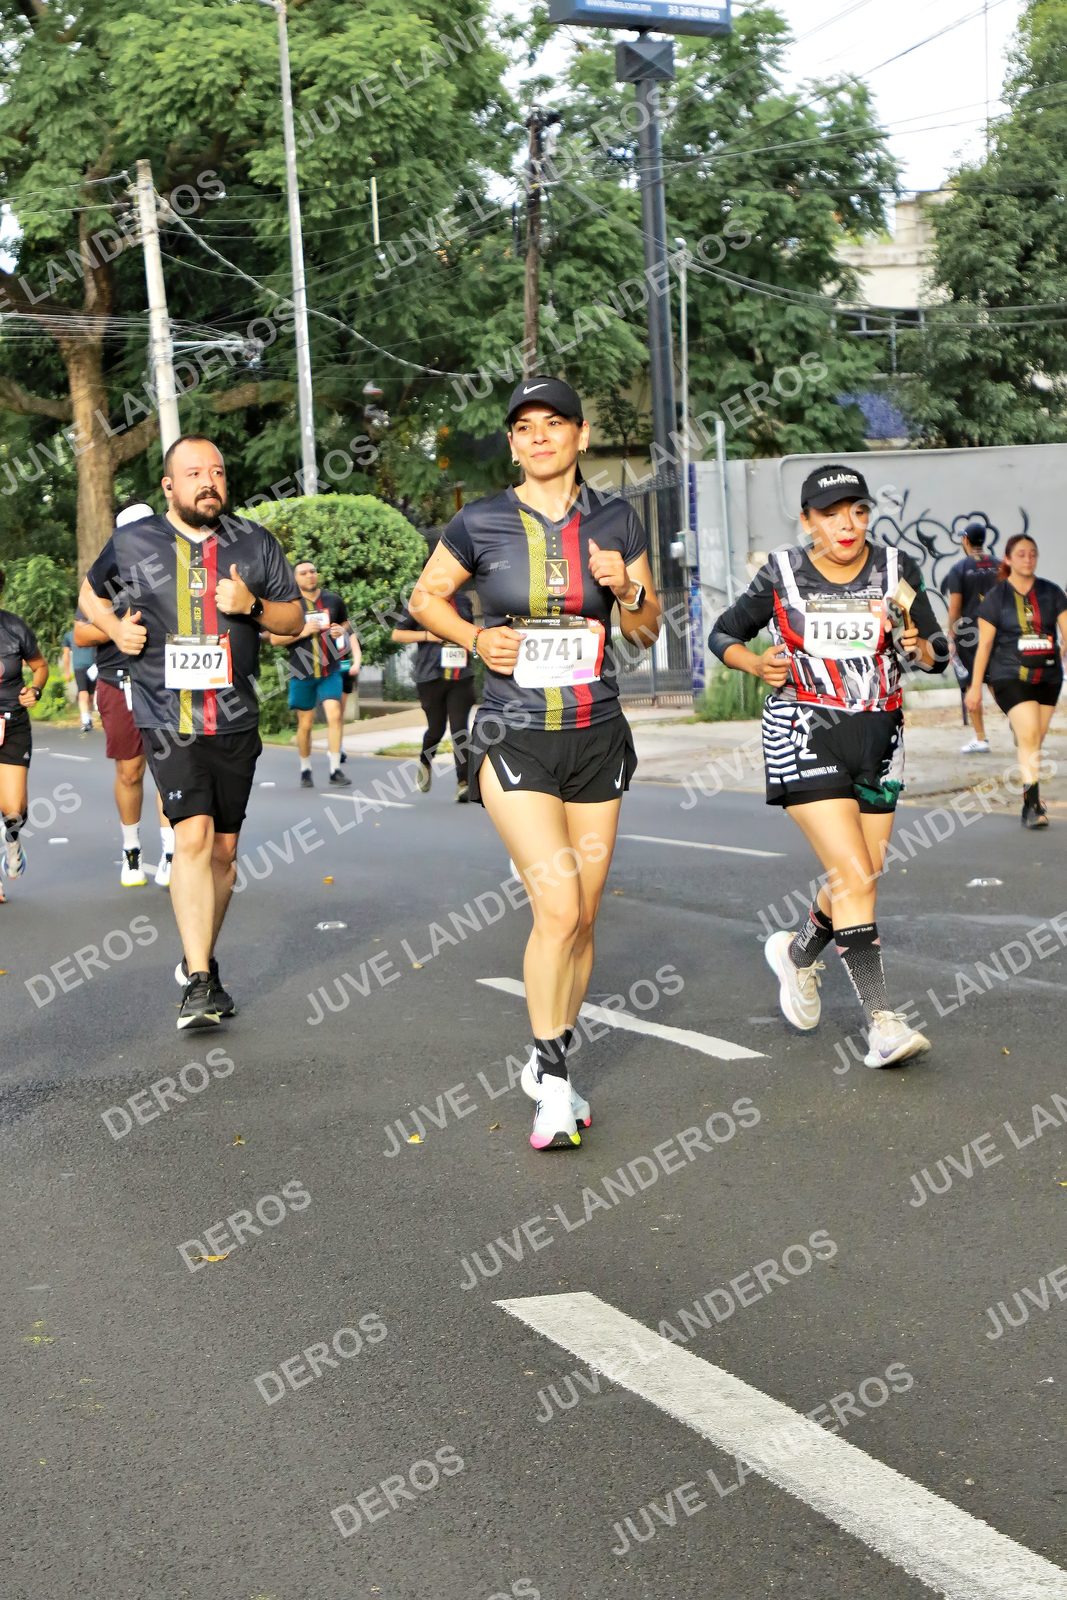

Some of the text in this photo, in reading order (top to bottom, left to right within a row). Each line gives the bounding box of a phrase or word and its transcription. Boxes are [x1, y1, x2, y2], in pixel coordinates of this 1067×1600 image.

[810, 620, 874, 640] 11635
[525, 637, 583, 661] 8741
[169, 652, 223, 669] 12207
[800, 765, 839, 778] RUNNING MX
